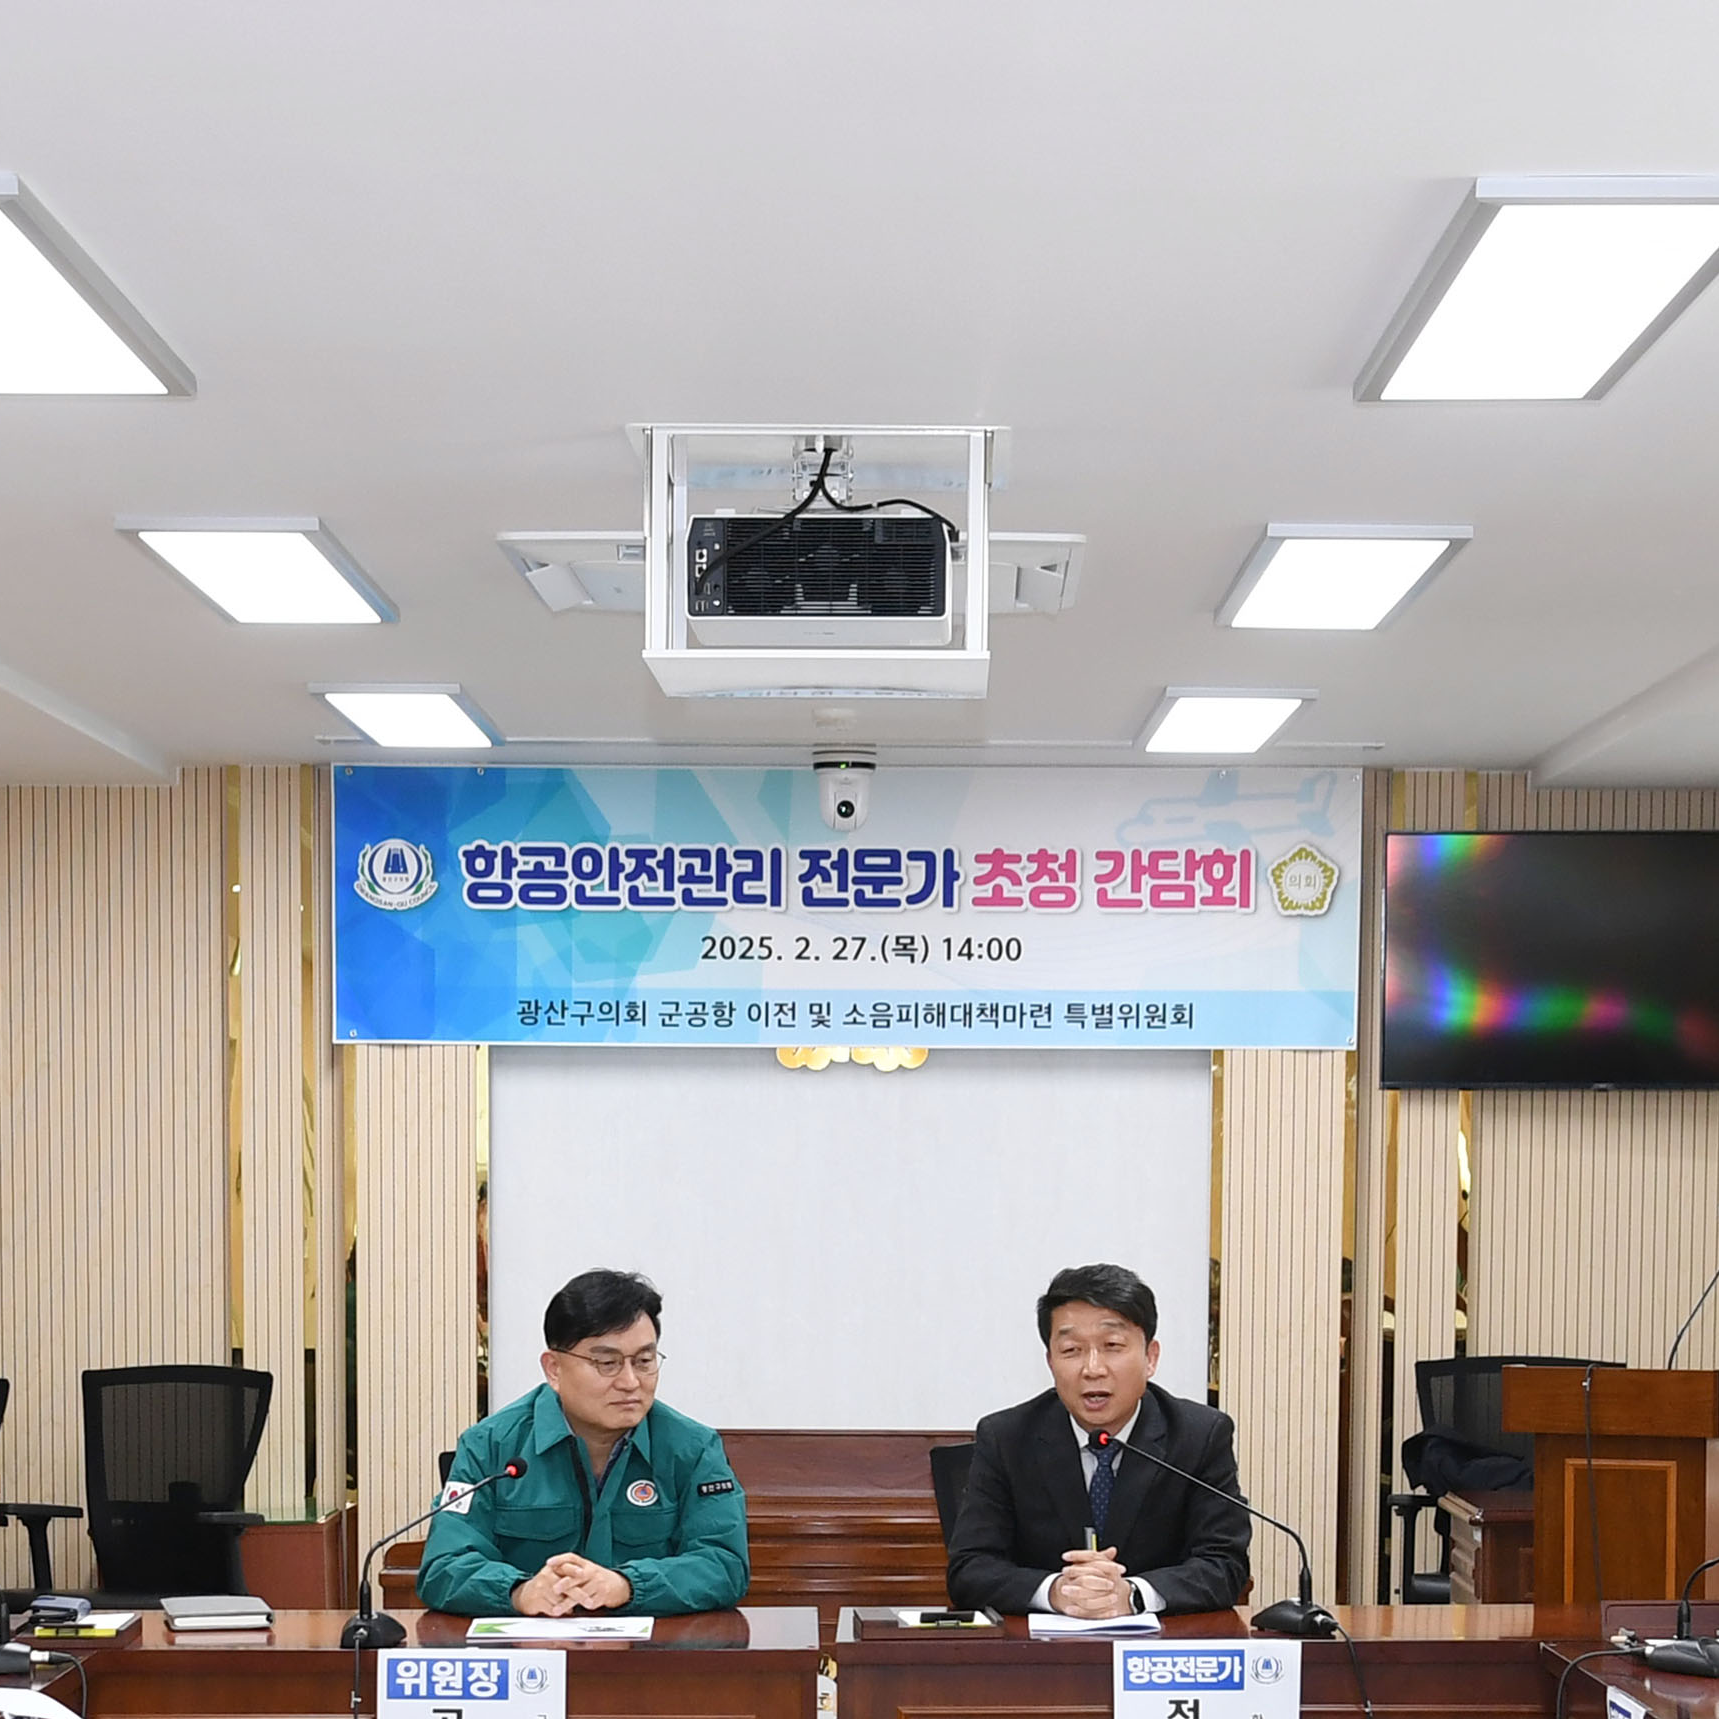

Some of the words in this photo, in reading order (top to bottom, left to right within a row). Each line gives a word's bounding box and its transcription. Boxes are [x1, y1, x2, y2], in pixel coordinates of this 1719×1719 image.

[462, 846, 781, 908] 항공안전관리
[797, 846, 960, 908] 전문가
[971, 847, 1077, 909] 초청
[1094, 847, 1251, 909] 간담회
[701, 936, 783, 961] 2025.
[794, 936, 821, 961] 2.
[832, 935, 929, 964] 27.(목)
[942, 936, 1022, 961] 14:00
[516, 999, 648, 1028] 광산구의회
[657, 1000, 737, 1028] 군공항
[747, 1001, 797, 1028] 이전
[808, 1001, 832, 1029] 및
[842, 1001, 1053, 1030] 소음피해대책마련
[1063, 1002, 1194, 1030] 특별위원회
[395, 1660, 502, 1698] 위원장
[1127, 1656, 1243, 1684] 항공전문가
